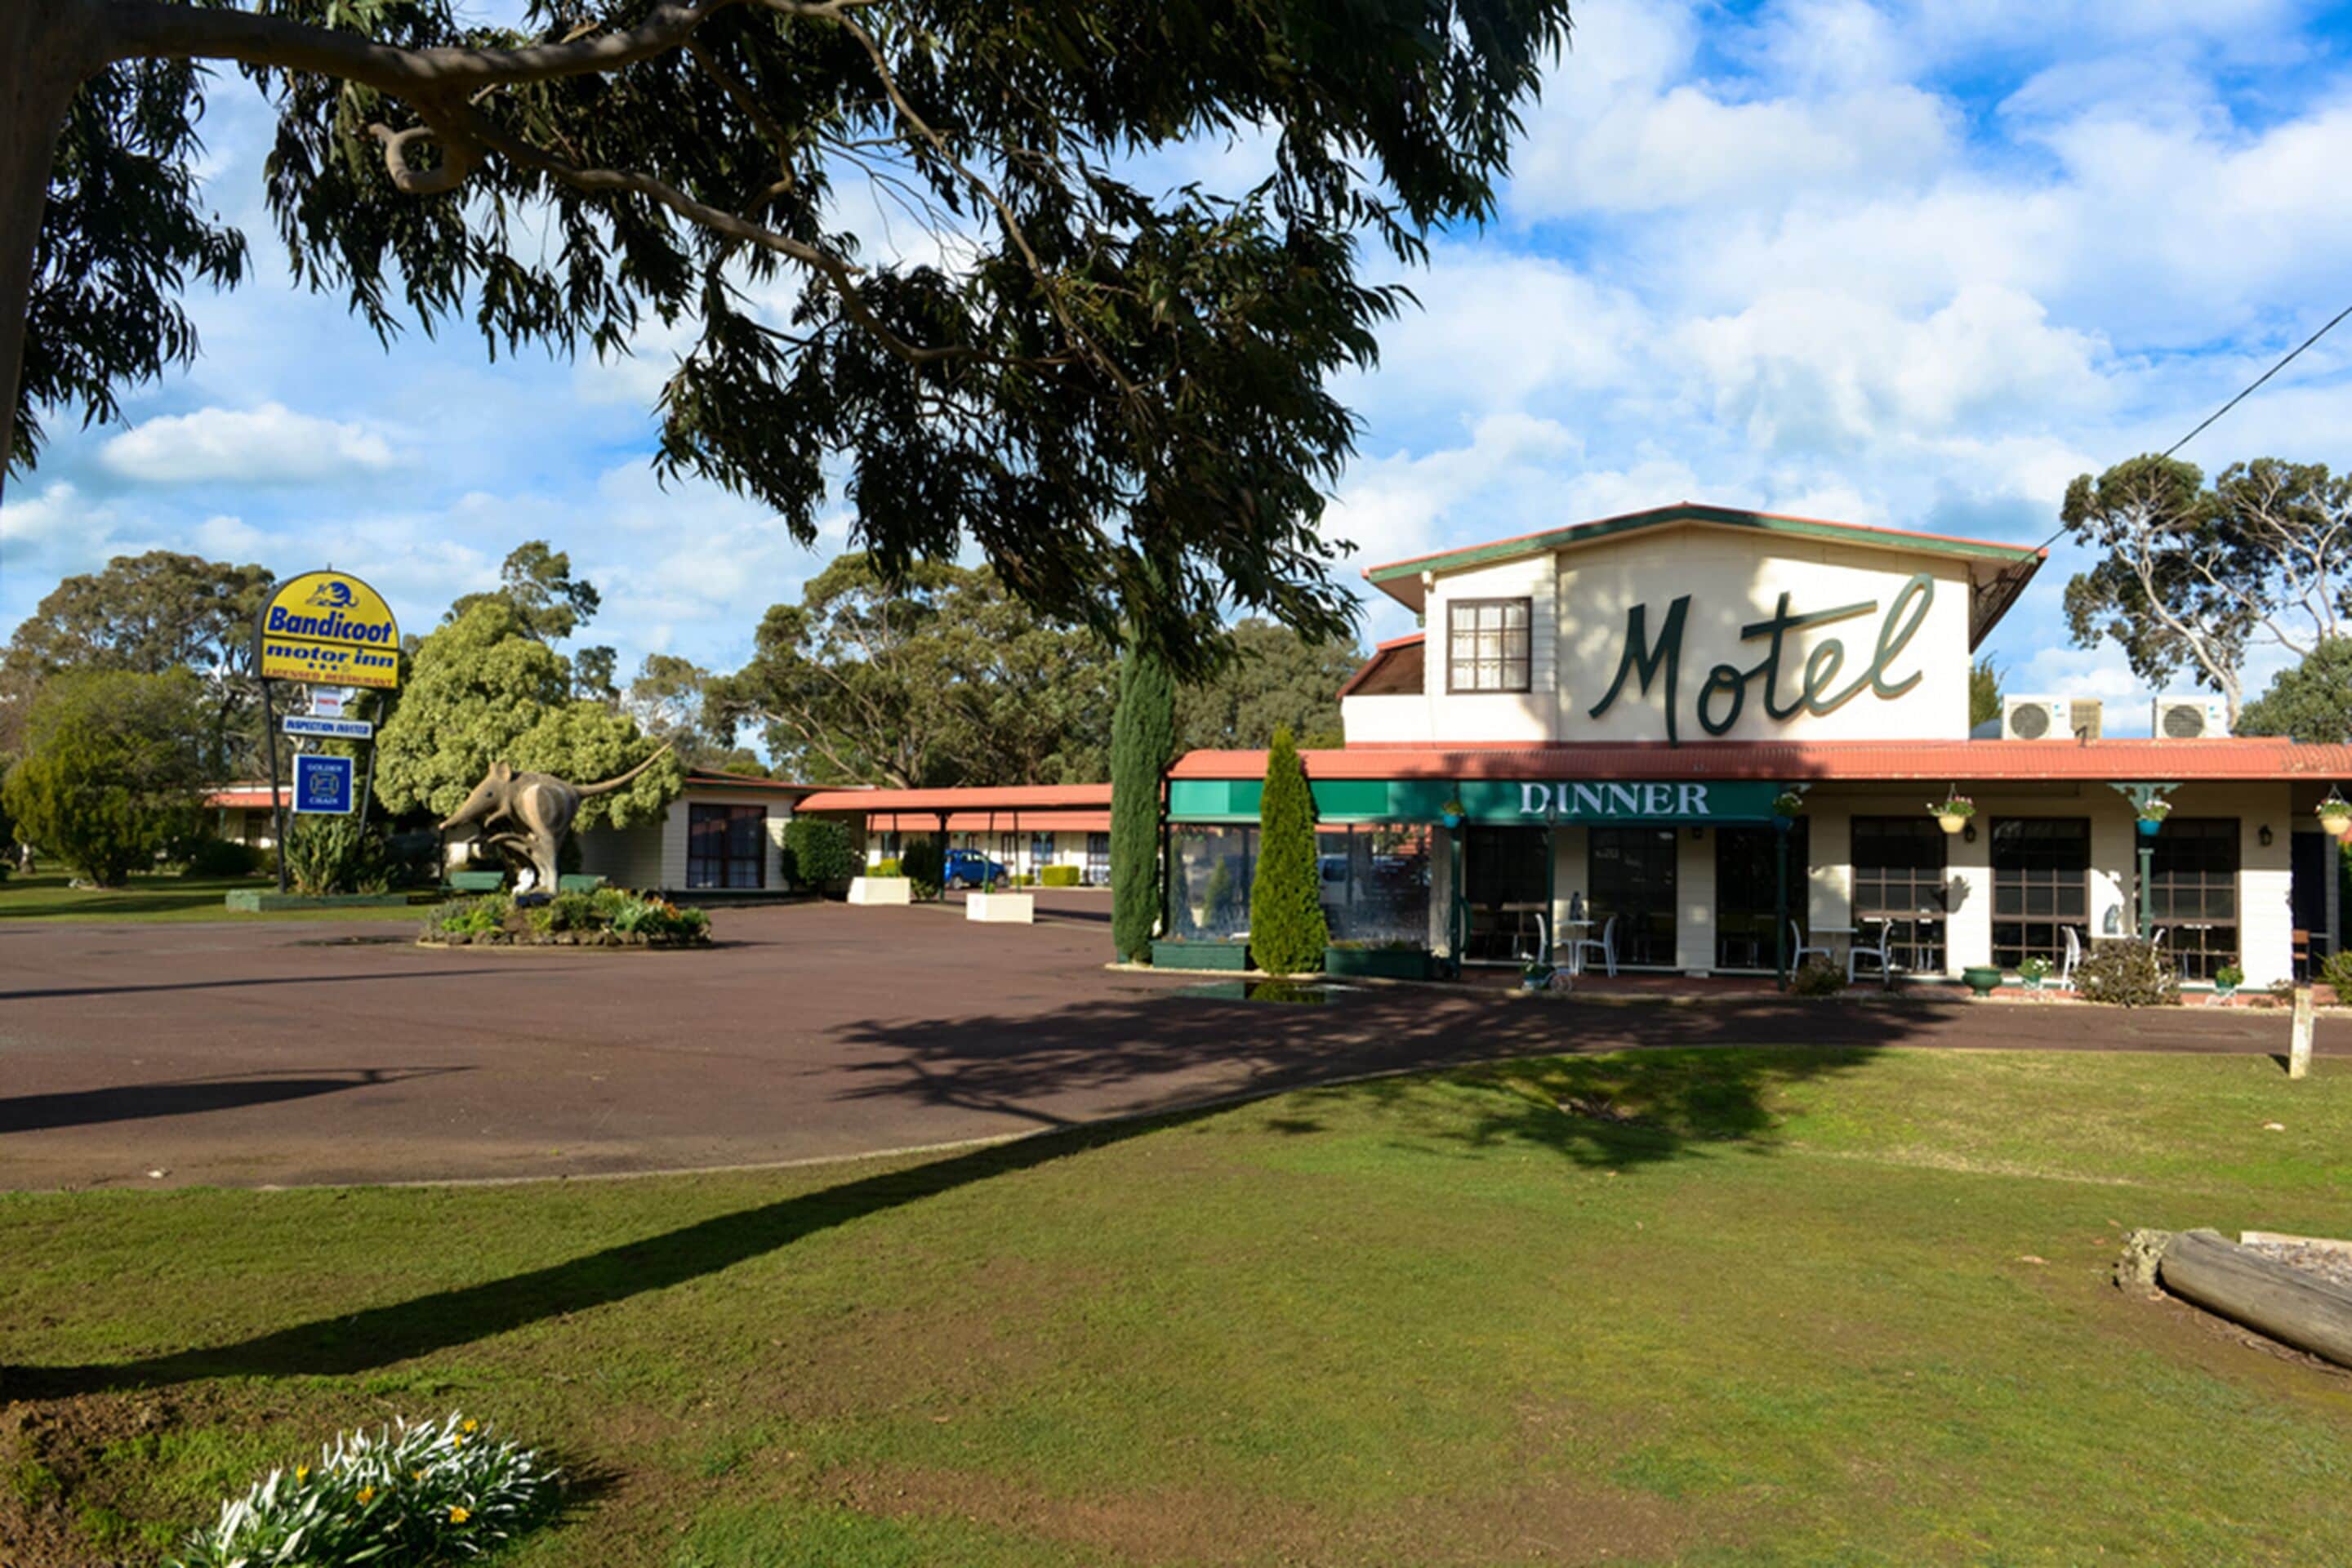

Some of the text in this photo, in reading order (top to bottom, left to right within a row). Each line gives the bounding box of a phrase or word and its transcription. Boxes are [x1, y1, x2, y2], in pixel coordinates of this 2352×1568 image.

[268, 606, 392, 644] Bandicoot
[266, 645, 394, 667] motor inn
[1588, 572, 1934, 746] Motel
[306, 764, 343, 772] GOLDEN
[1519, 782, 1711, 814] DINNER
